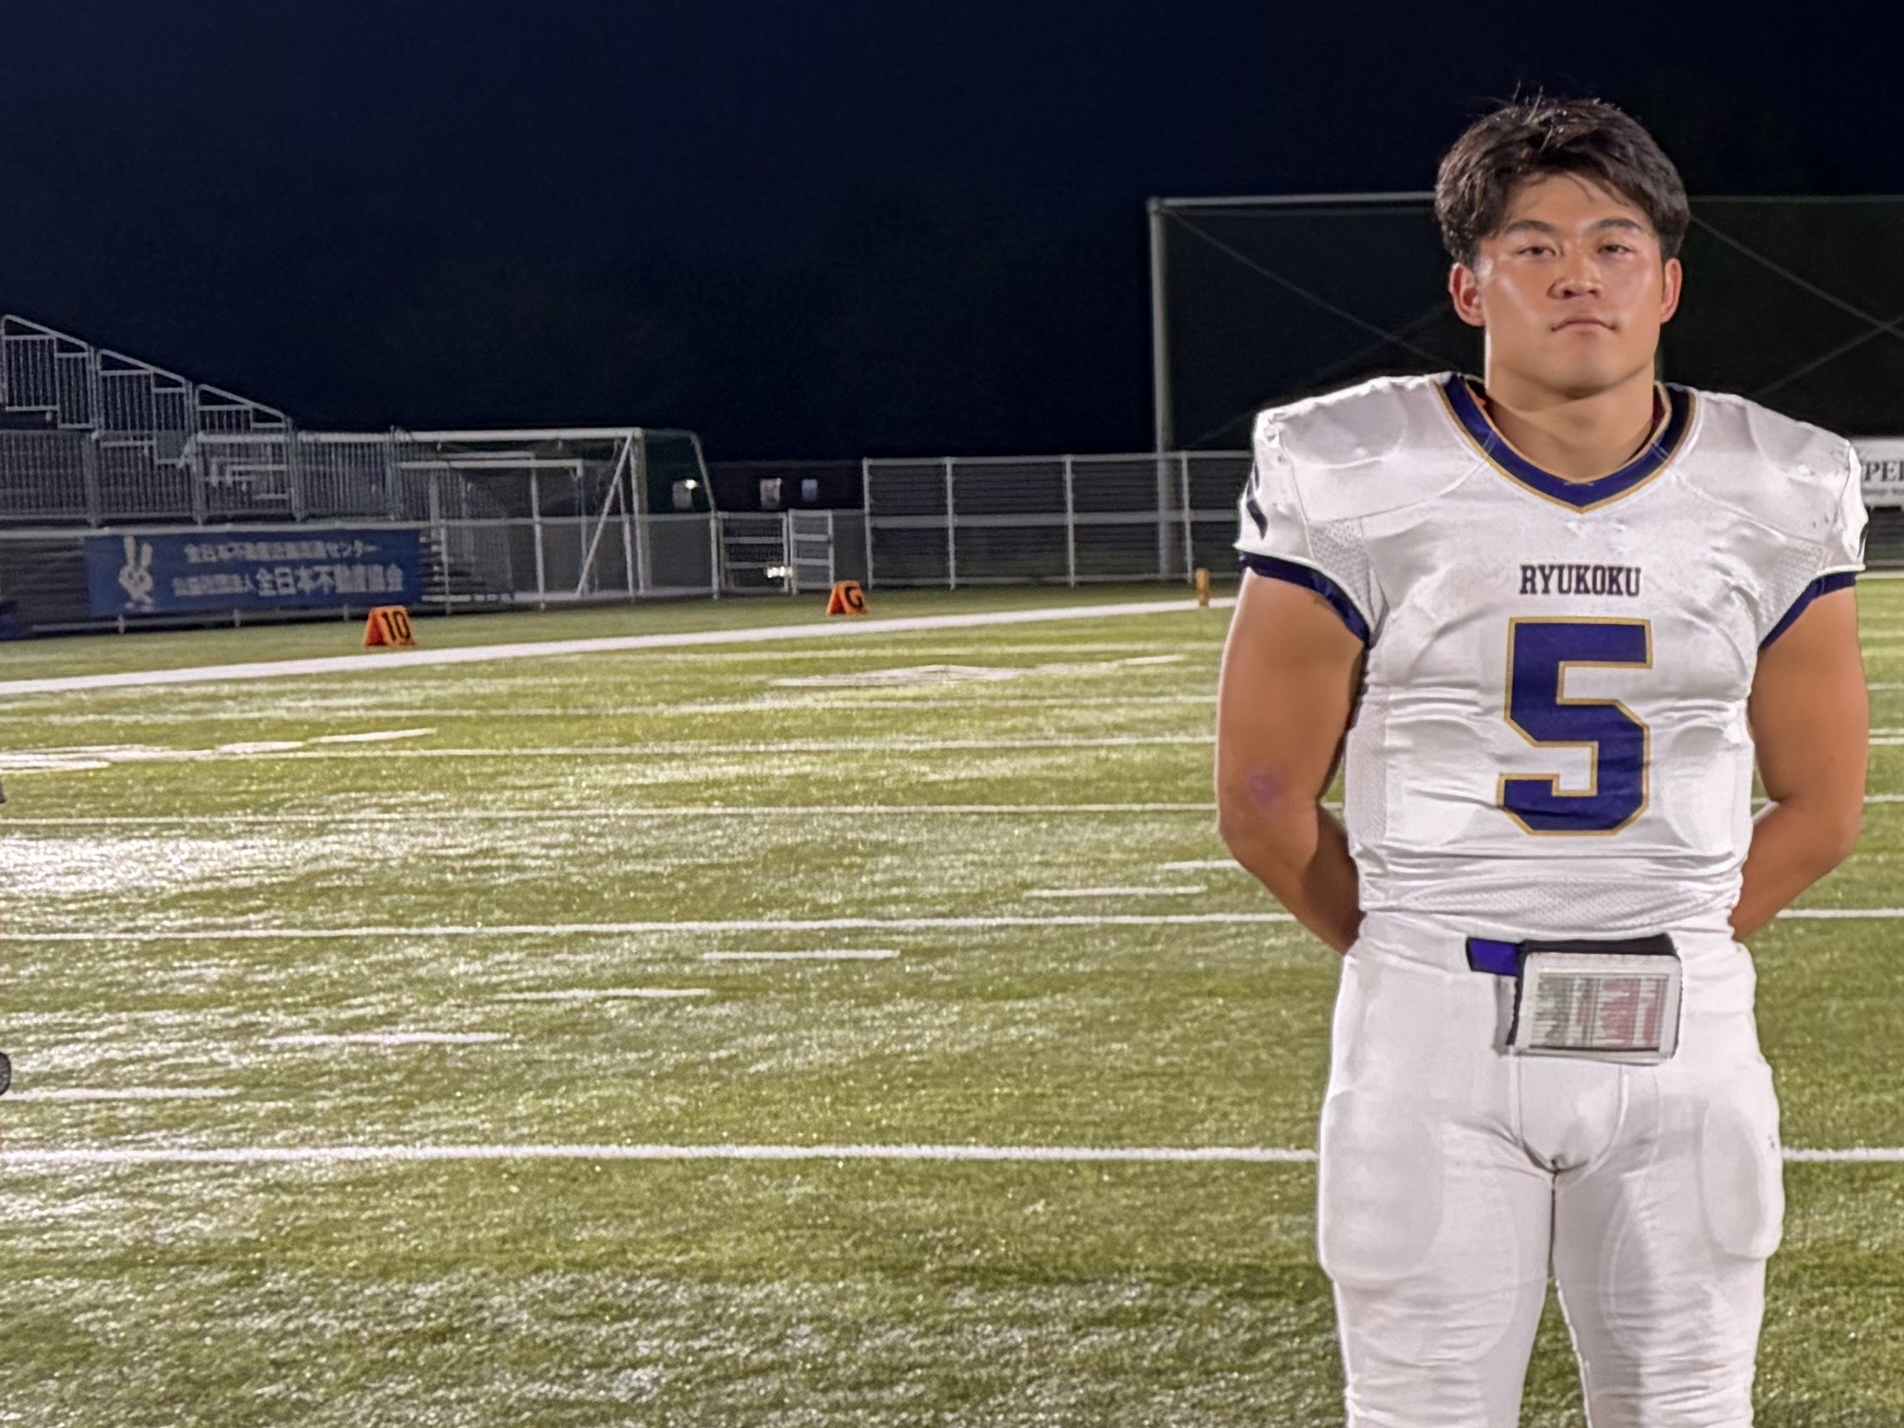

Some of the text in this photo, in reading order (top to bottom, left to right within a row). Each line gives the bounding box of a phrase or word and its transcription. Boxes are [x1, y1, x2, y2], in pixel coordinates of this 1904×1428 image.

[1519, 564, 1642, 597] RYUKOKU
[845, 586, 864, 610] G
[381, 610, 411, 642] 10
[1495, 616, 1653, 837] 5
